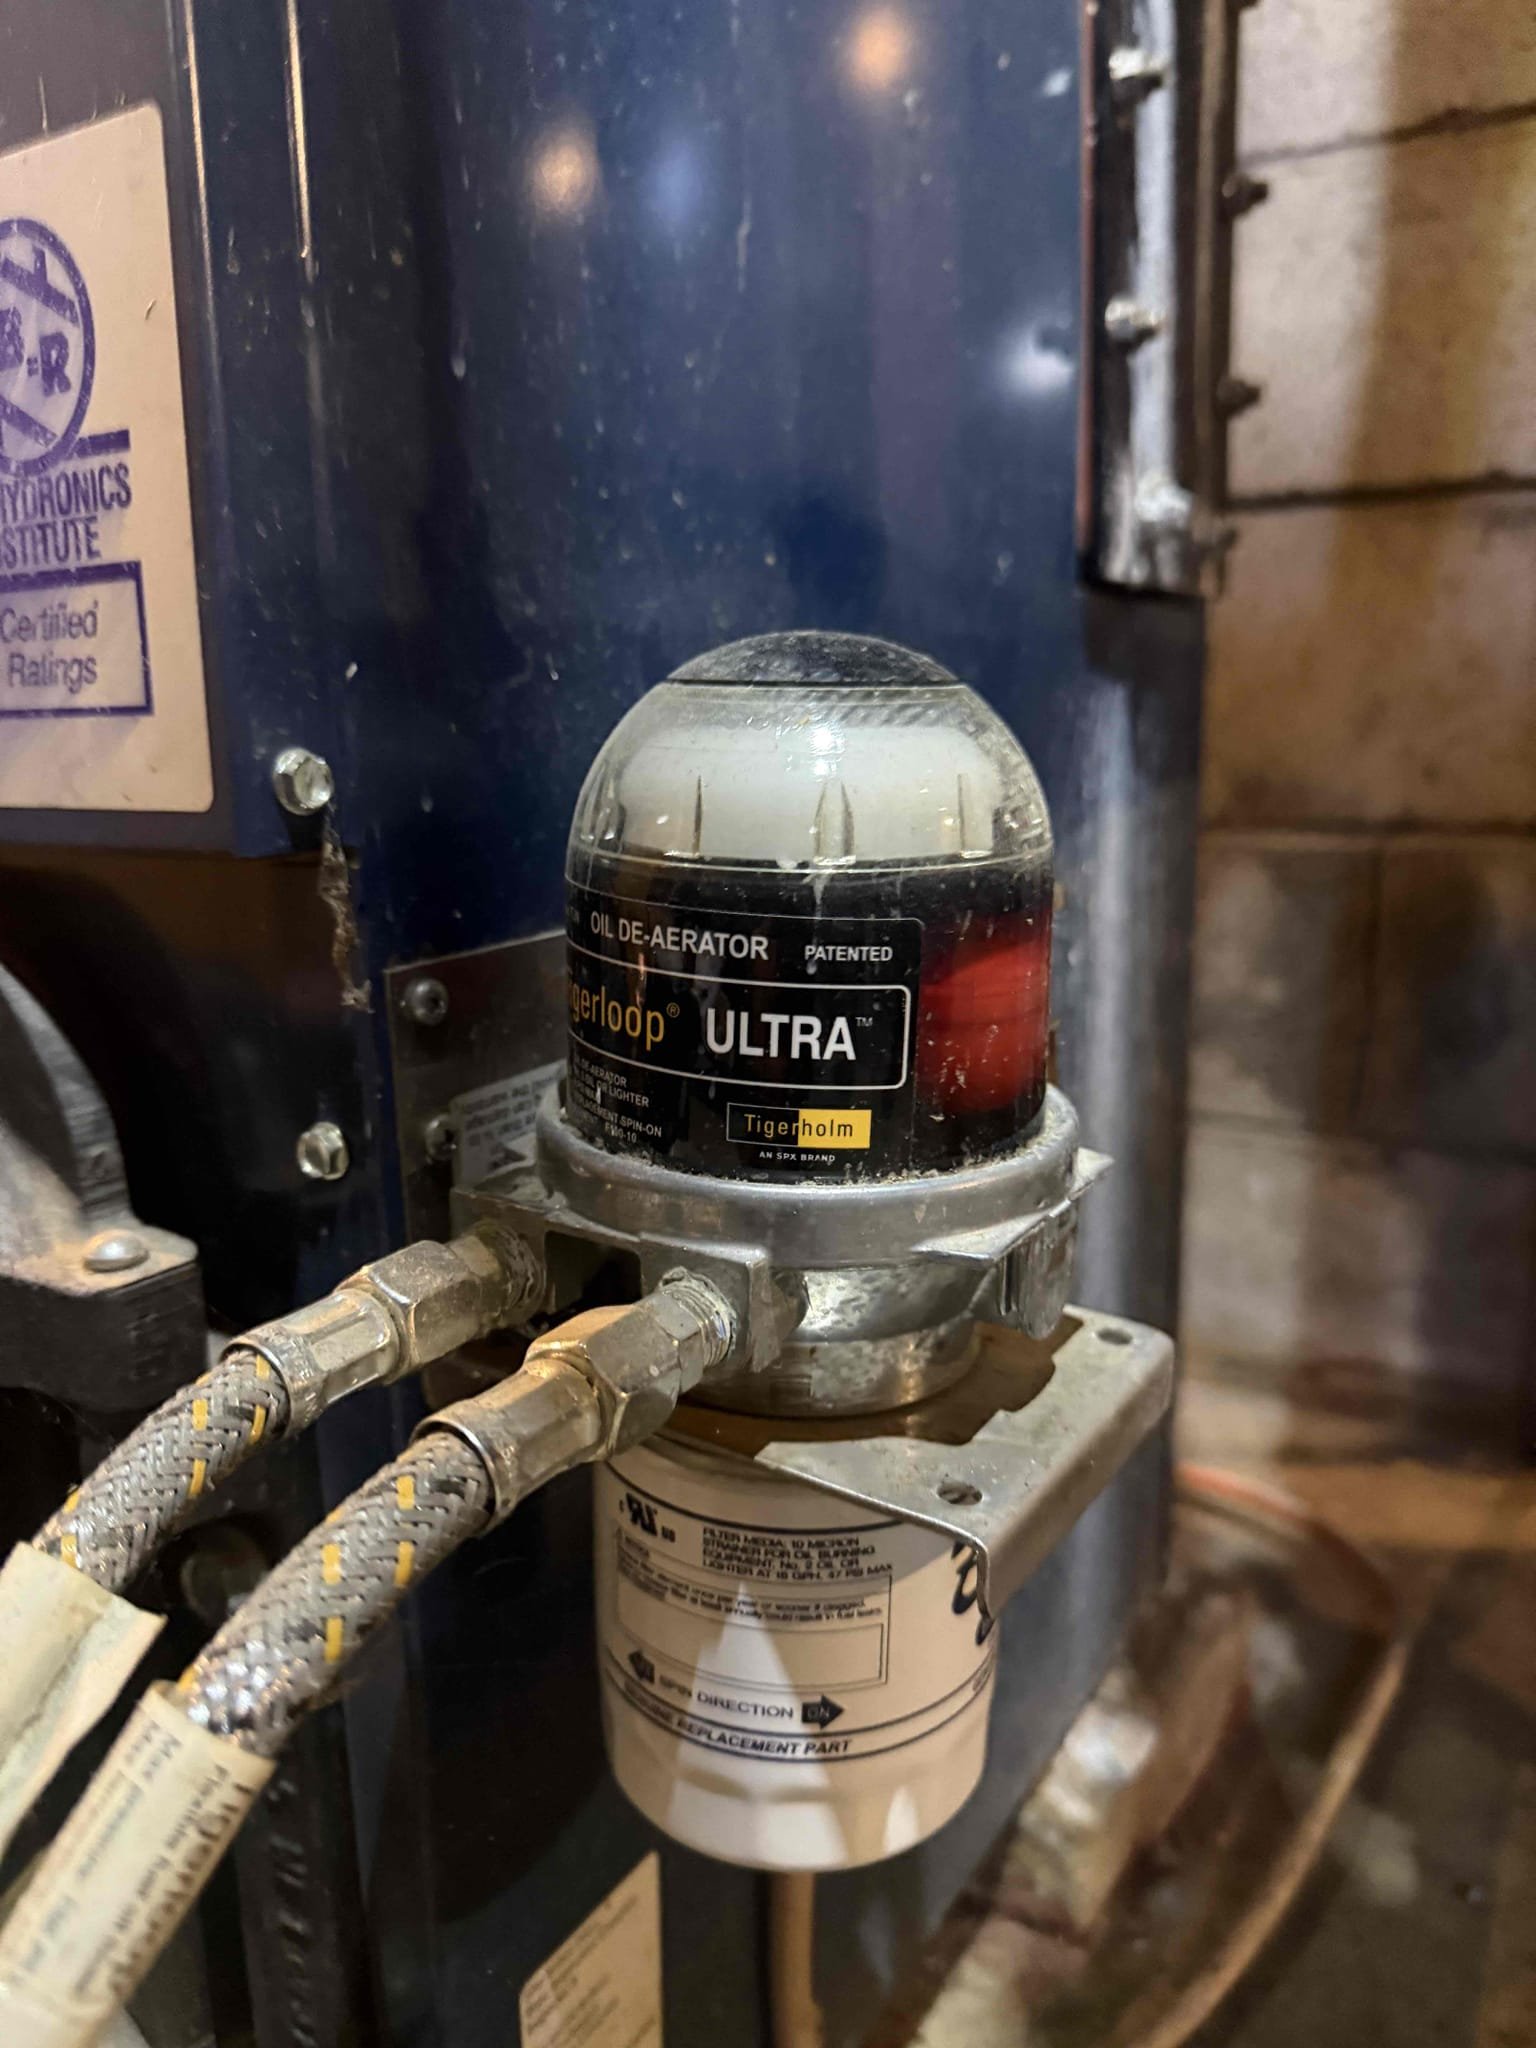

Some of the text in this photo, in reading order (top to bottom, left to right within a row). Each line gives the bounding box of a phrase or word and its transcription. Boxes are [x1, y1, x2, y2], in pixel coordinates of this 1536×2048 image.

[8, 650, 98, 694] Ratings
[591, 910, 613, 938] OIL
[619, 917, 768, 961] DE-AERATOR
[804, 945, 893, 962] PATENTED
[609, 1085, 650, 1108] LIGHTER
[621, 1115, 662, 1138] SPIN-ON
[744, 1114, 853, 1138] Tigerholm
[760, 1151, 836, 1162] AN SPX BRAND
[697, 1691, 793, 1719] DIRECTION
[677, 1716, 801, 1753] REPLACEMENT
[803, 1739, 852, 1755] PART
